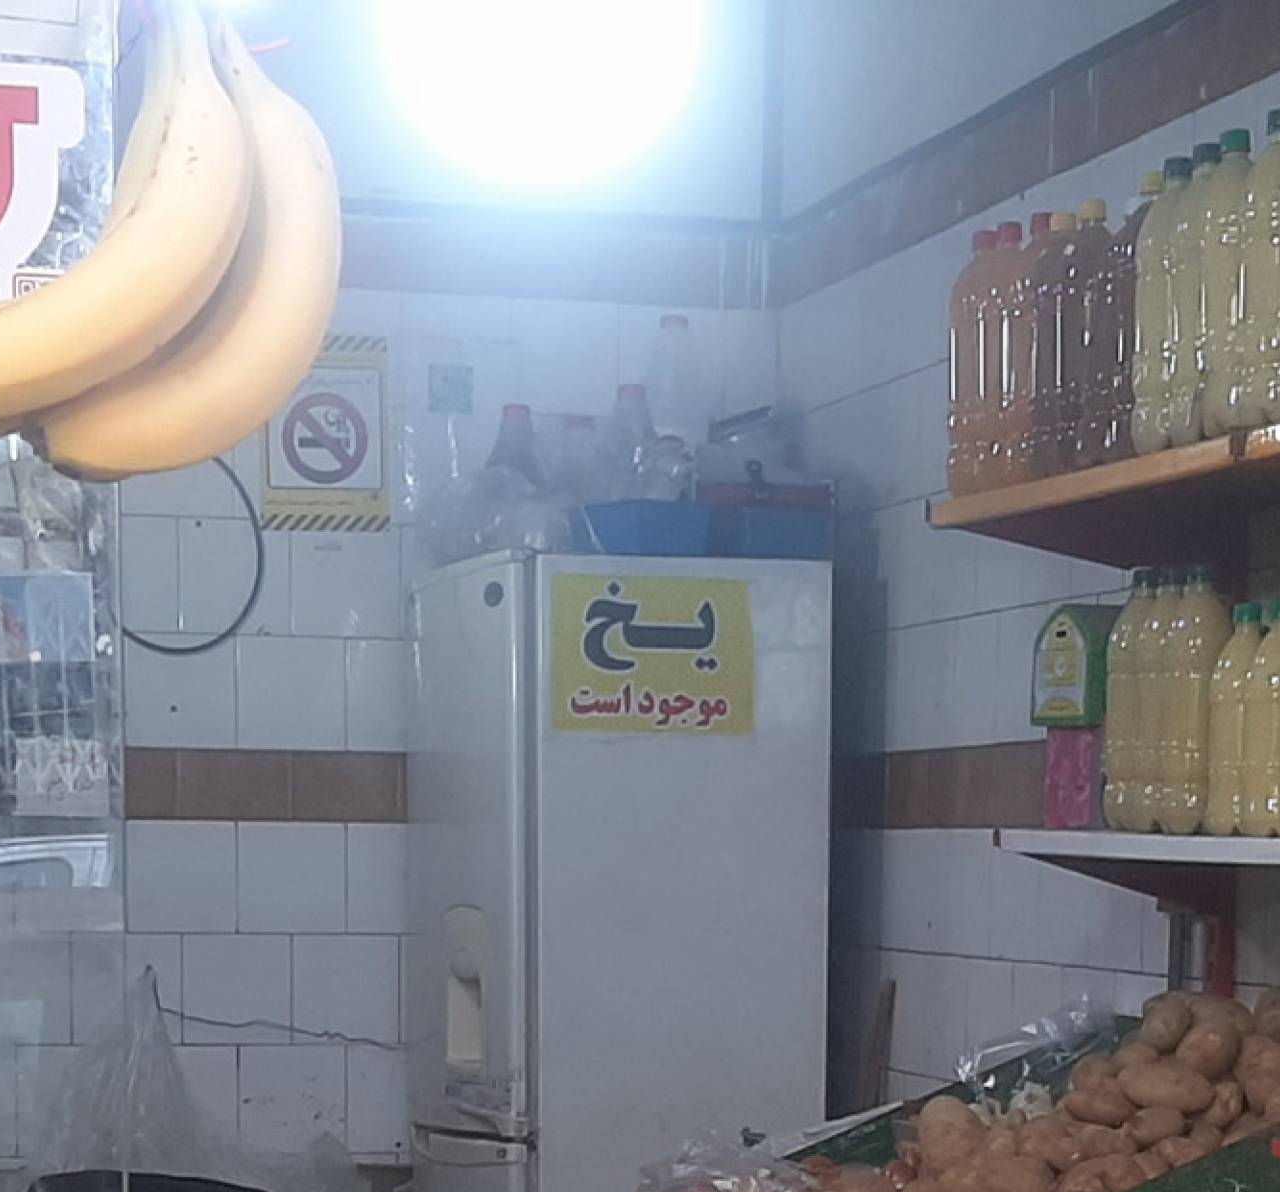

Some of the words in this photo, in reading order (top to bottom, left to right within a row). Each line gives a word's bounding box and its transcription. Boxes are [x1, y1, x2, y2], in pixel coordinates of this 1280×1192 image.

[583, 581, 718, 671] یخ
[571, 682, 632, 715] است
[638, 691, 729, 727] موجود
